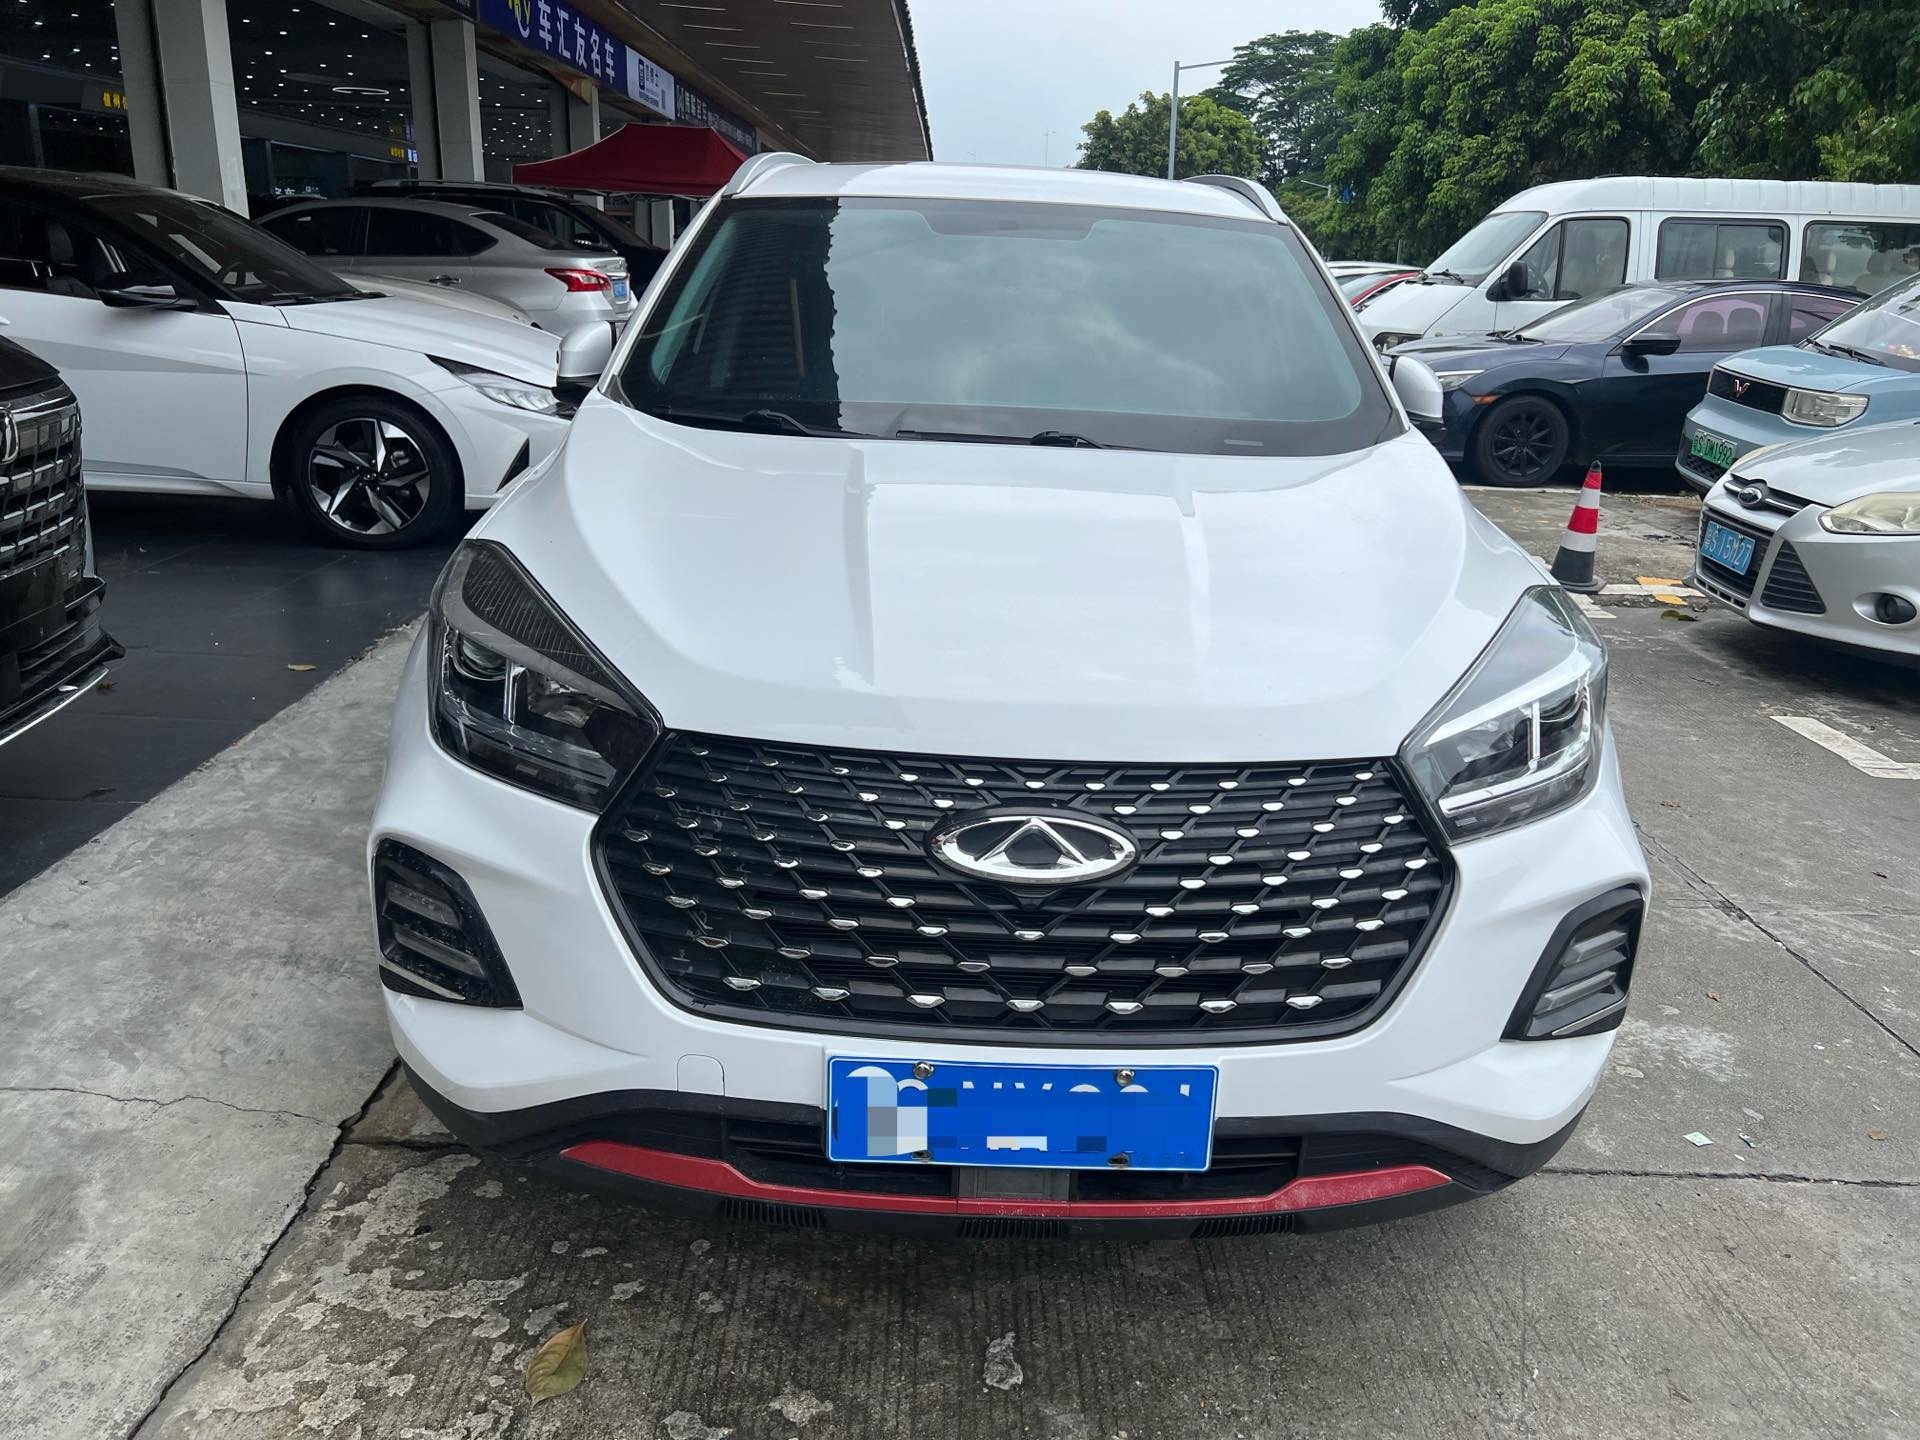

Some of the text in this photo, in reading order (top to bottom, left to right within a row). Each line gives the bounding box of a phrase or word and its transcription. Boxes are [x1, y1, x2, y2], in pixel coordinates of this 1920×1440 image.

[538, 0, 615, 84] 车汇友名车
